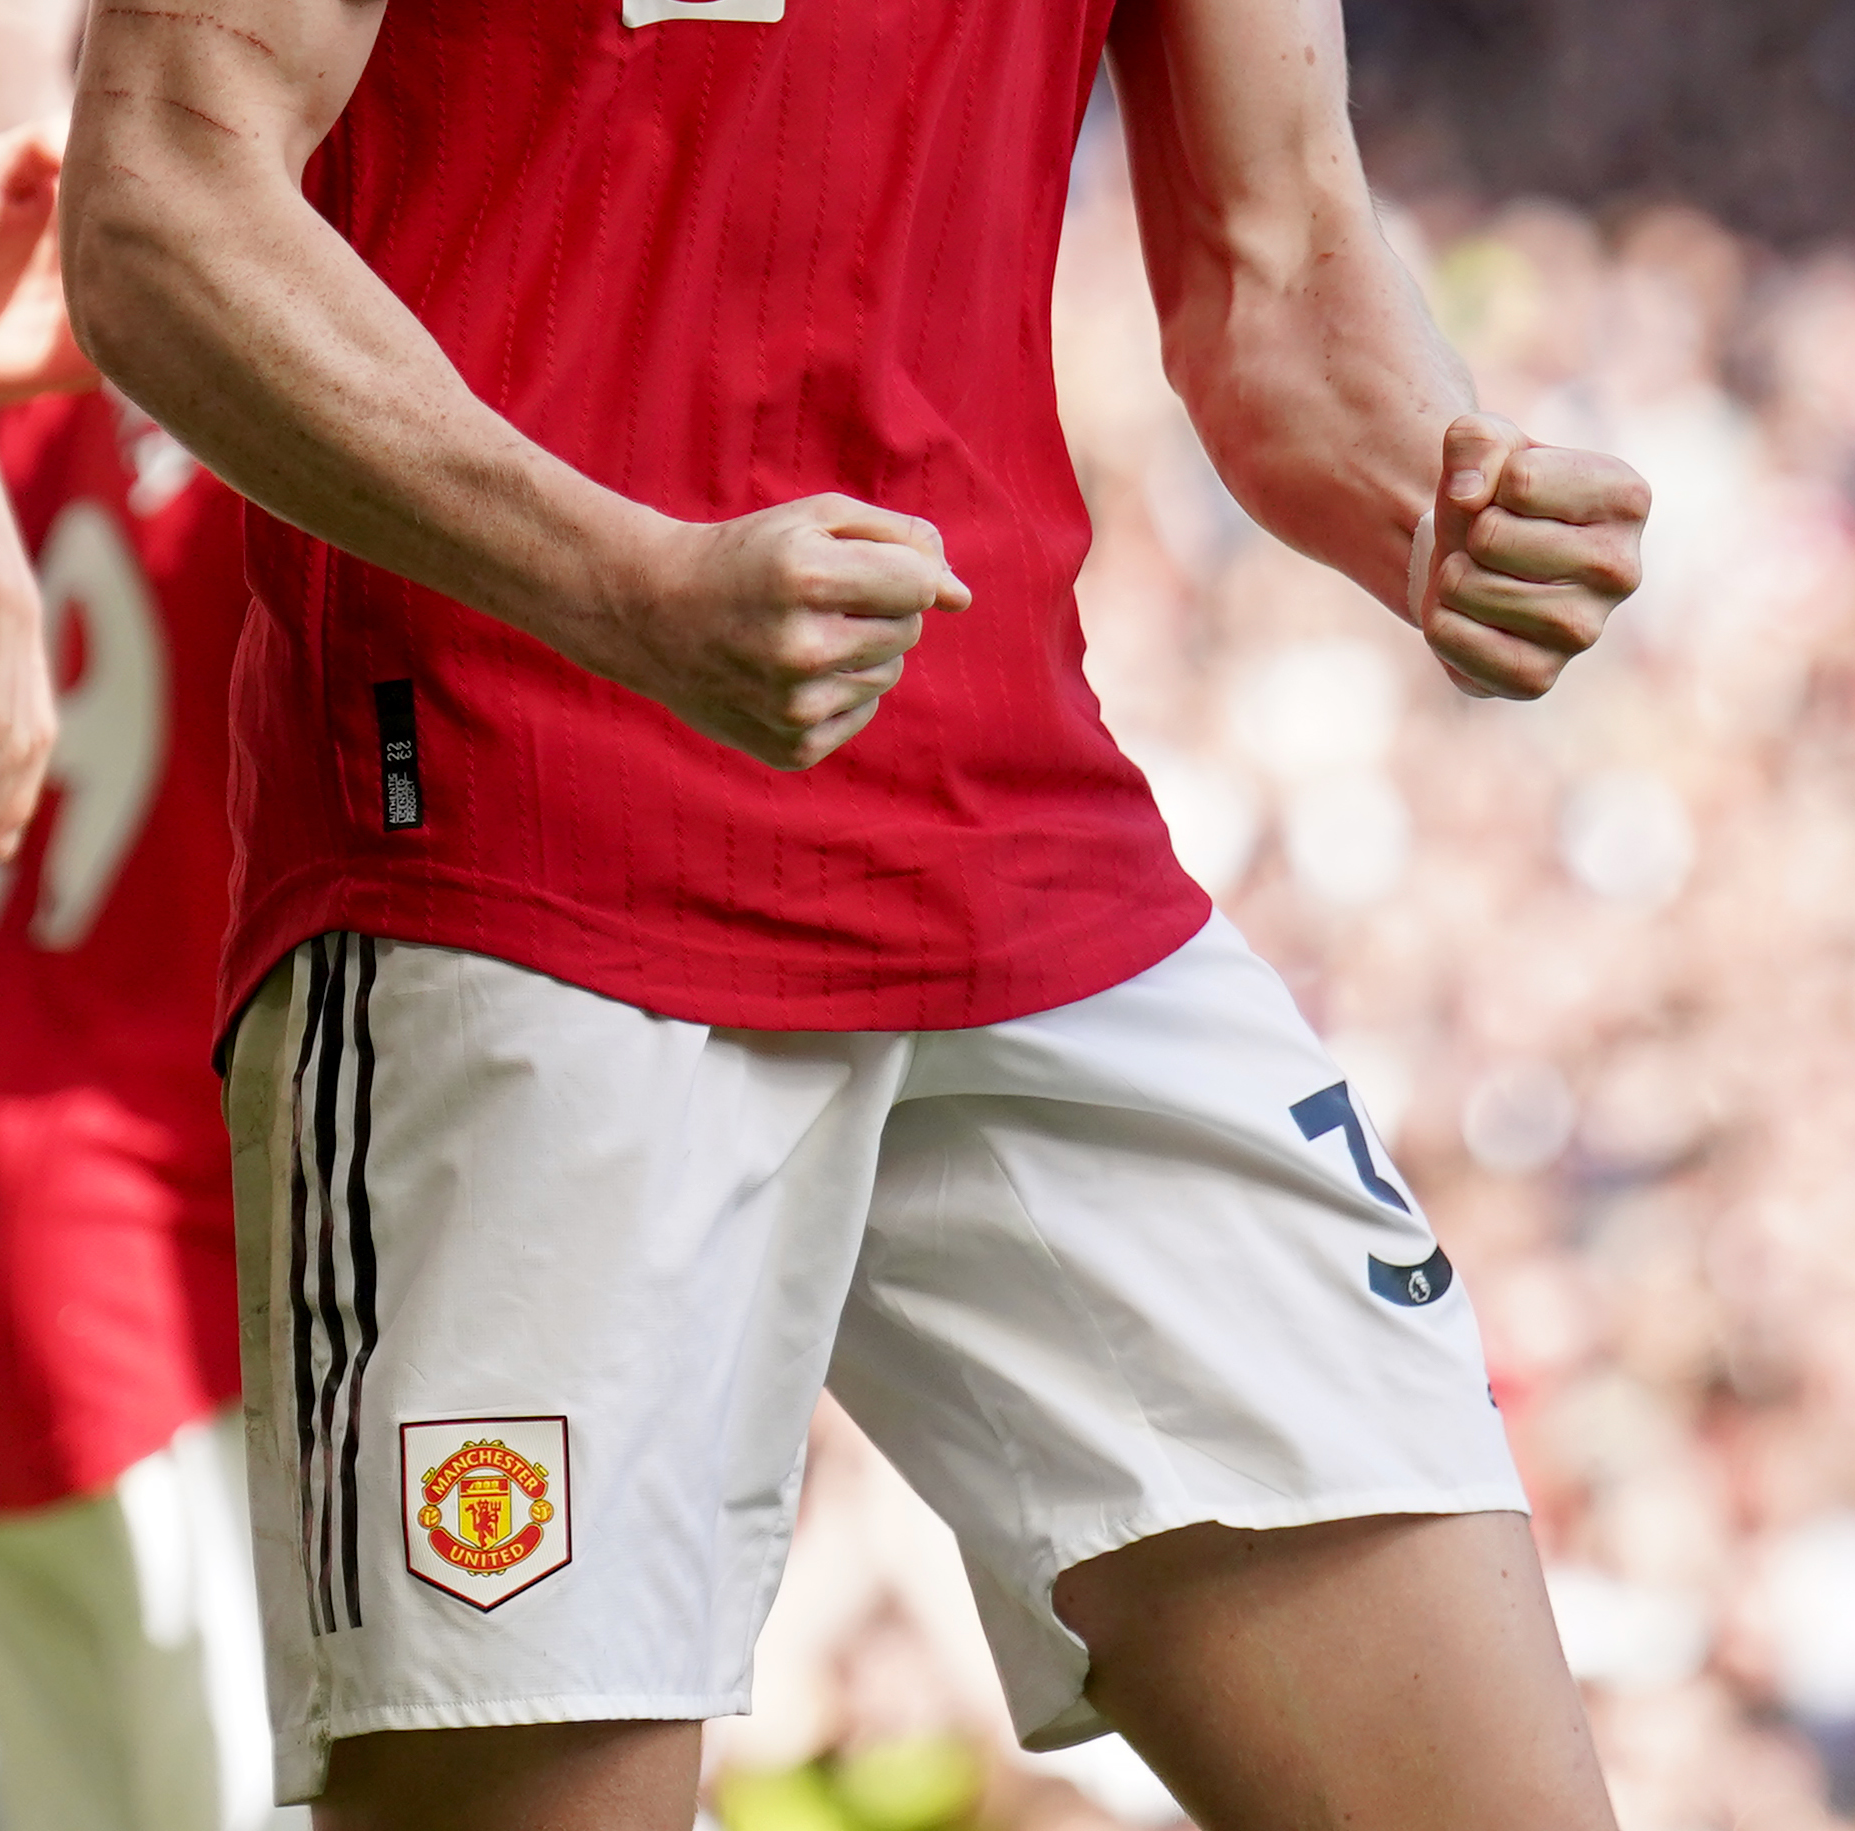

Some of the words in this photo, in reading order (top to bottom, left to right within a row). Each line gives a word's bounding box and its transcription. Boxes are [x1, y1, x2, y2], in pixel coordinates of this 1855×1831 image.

[386, 742, 400, 762] 22
[431, 1450, 540, 1497] MANCHESTER
[449, 1542, 525, 1568] UNITED
